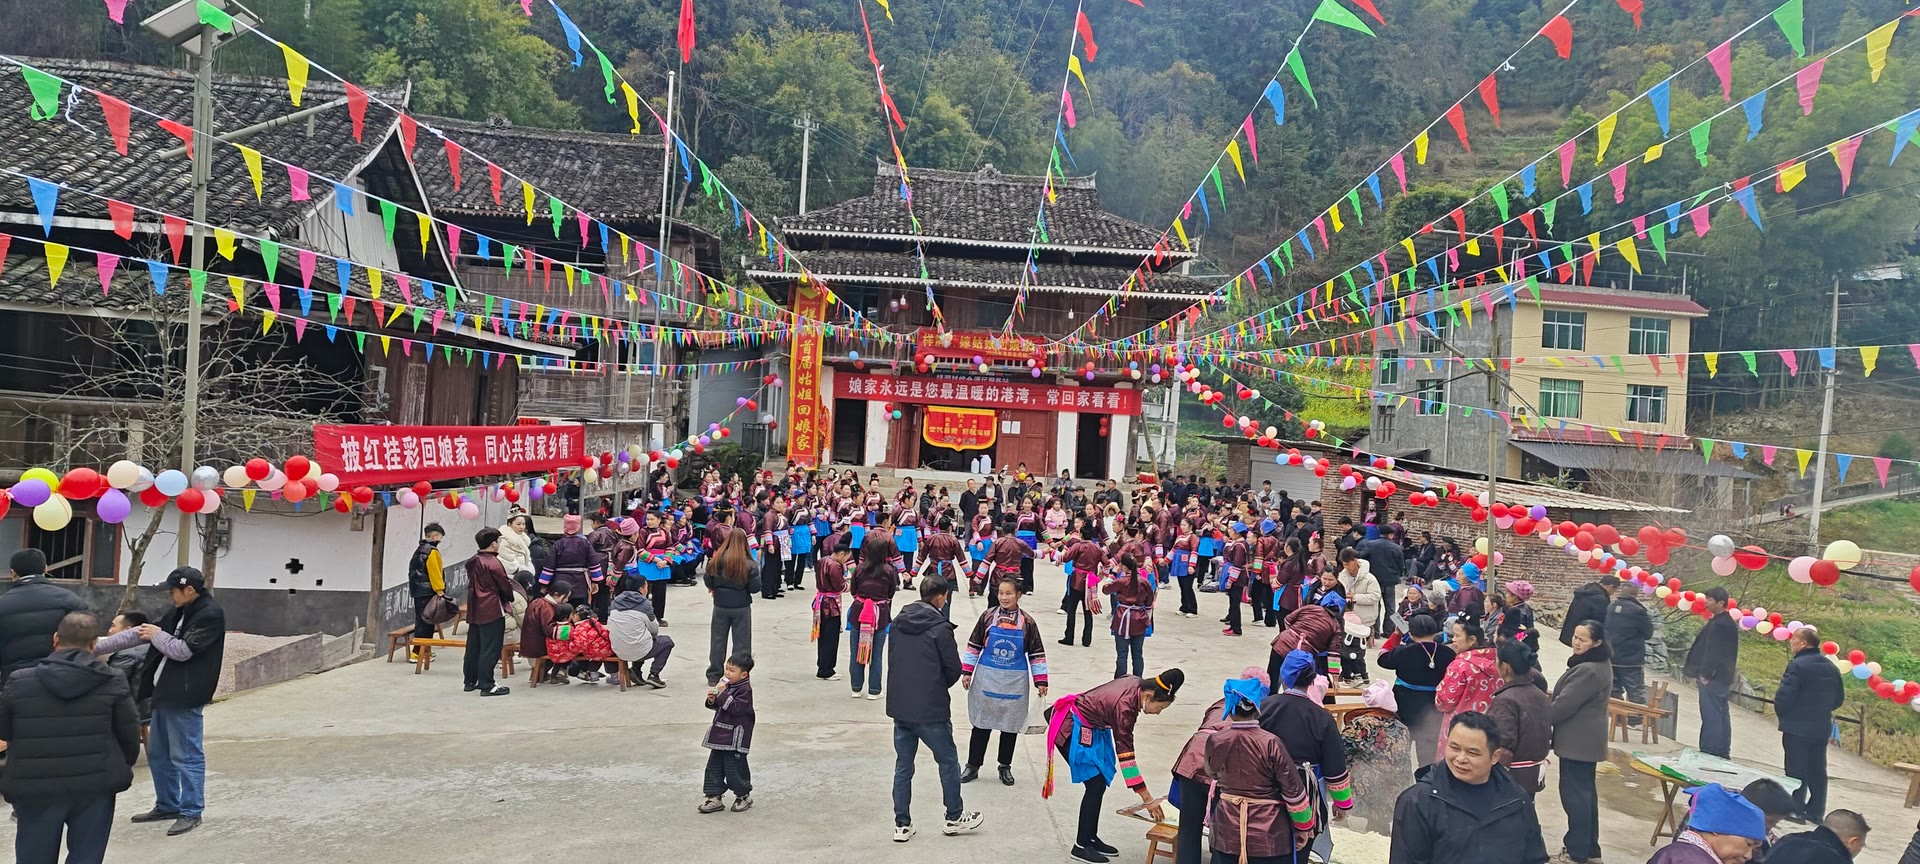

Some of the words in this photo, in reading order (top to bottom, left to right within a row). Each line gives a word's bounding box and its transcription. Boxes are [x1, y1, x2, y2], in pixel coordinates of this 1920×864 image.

[848, 377, 1128, 410] 娘家永远是您最温暖的港湾，常回家看看！
[340, 432, 573, 473] 披红挂彩回娘家，同心共叙家乡情！
